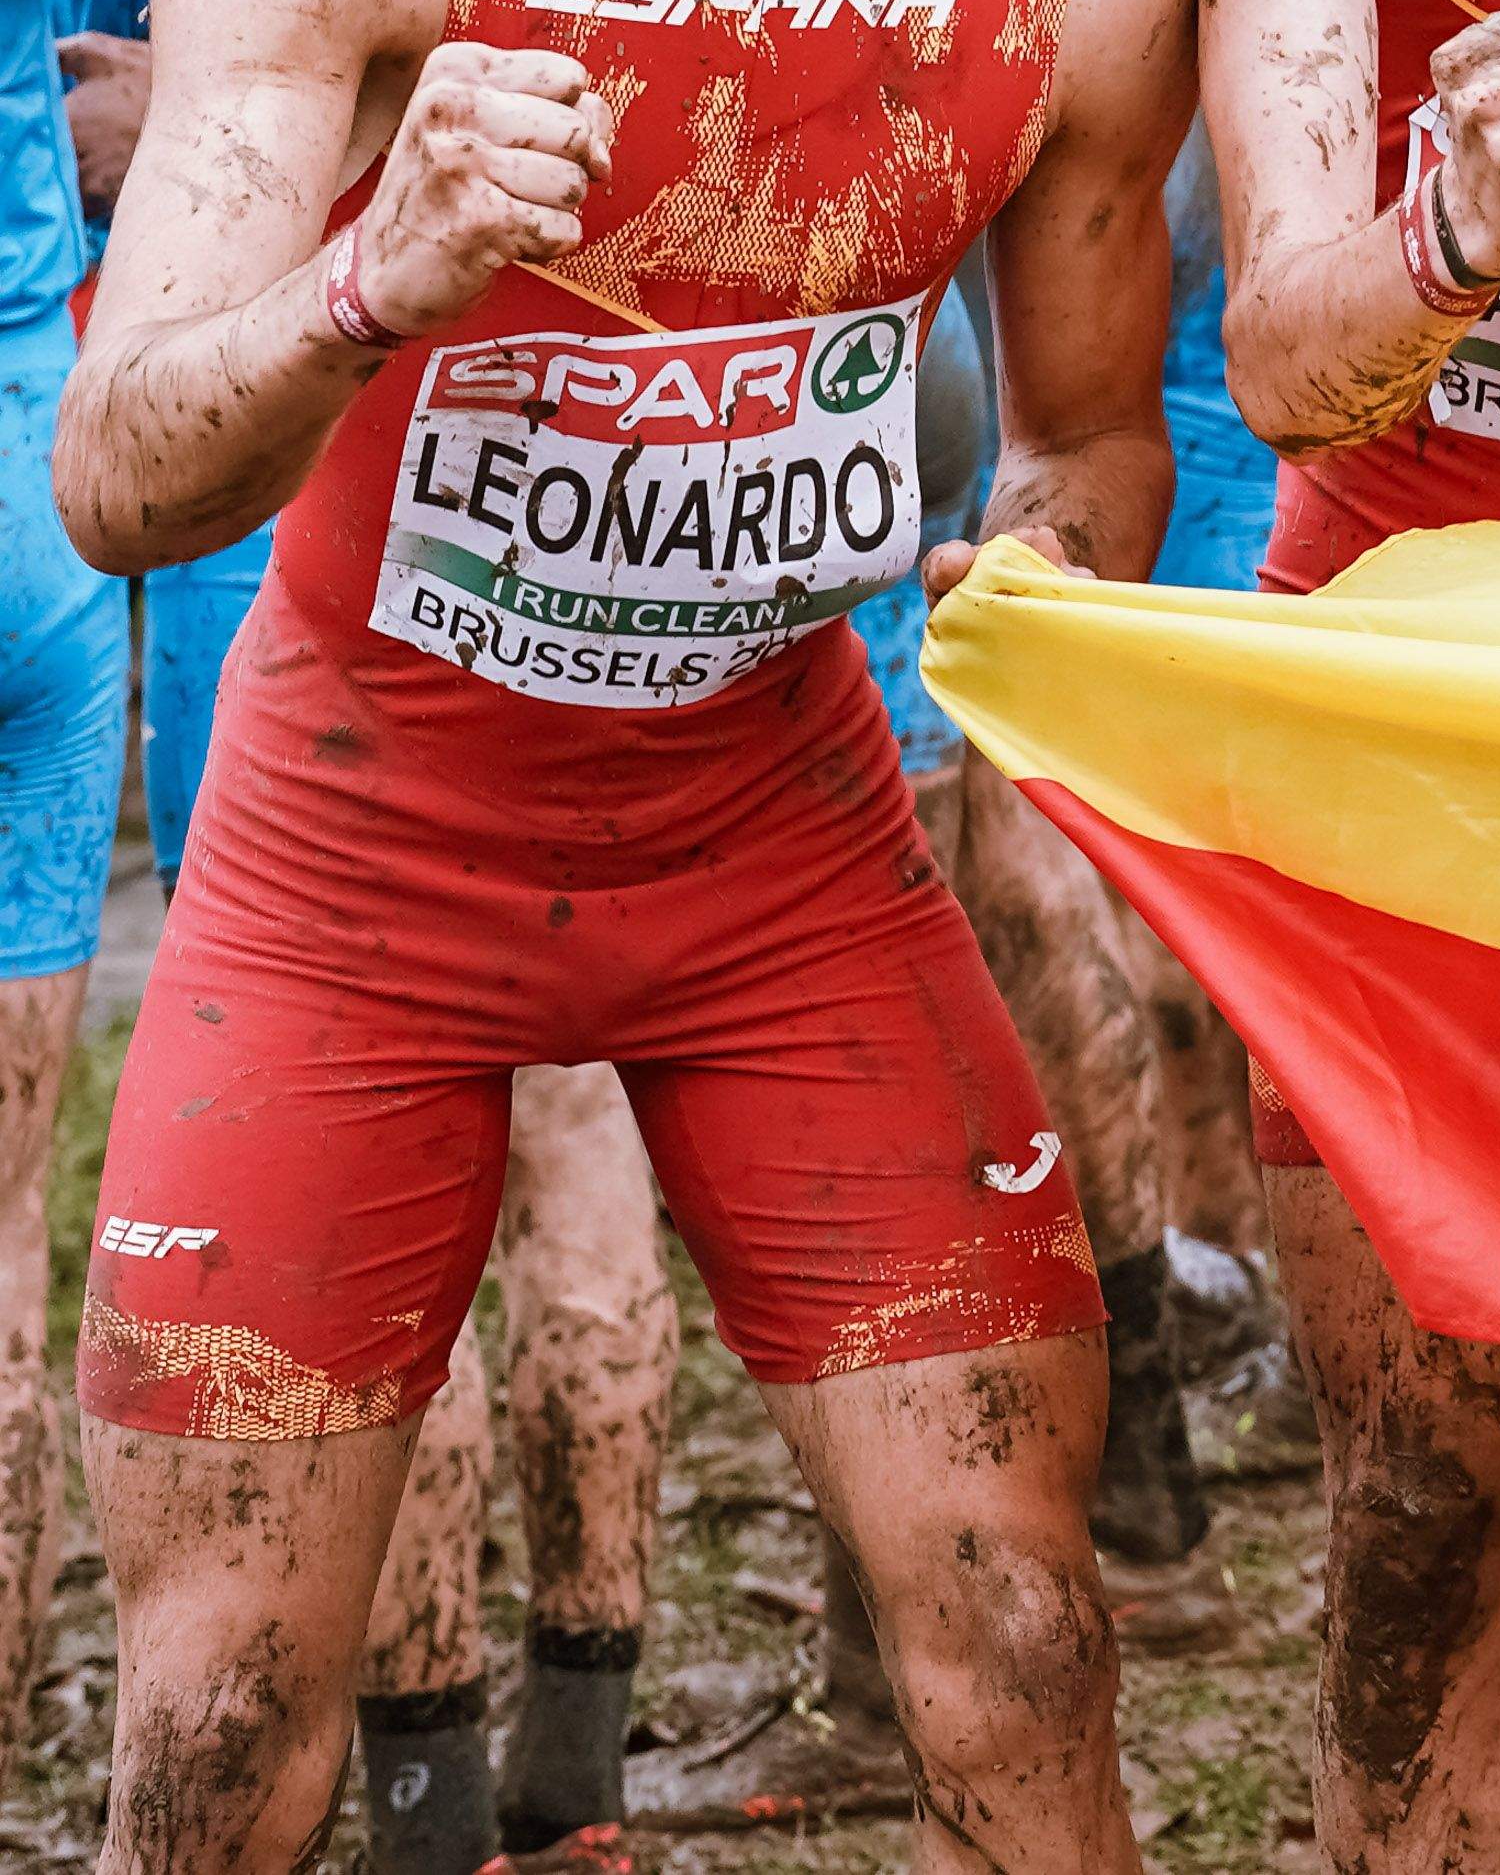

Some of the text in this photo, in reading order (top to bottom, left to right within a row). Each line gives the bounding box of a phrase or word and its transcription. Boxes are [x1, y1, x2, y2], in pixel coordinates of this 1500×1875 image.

[444, 345, 798, 431] SPAR
[412, 434, 895, 571] LEONARDO
[412, 586, 714, 688] BRUSSELS
[100, 1216, 218, 1259] ESP
